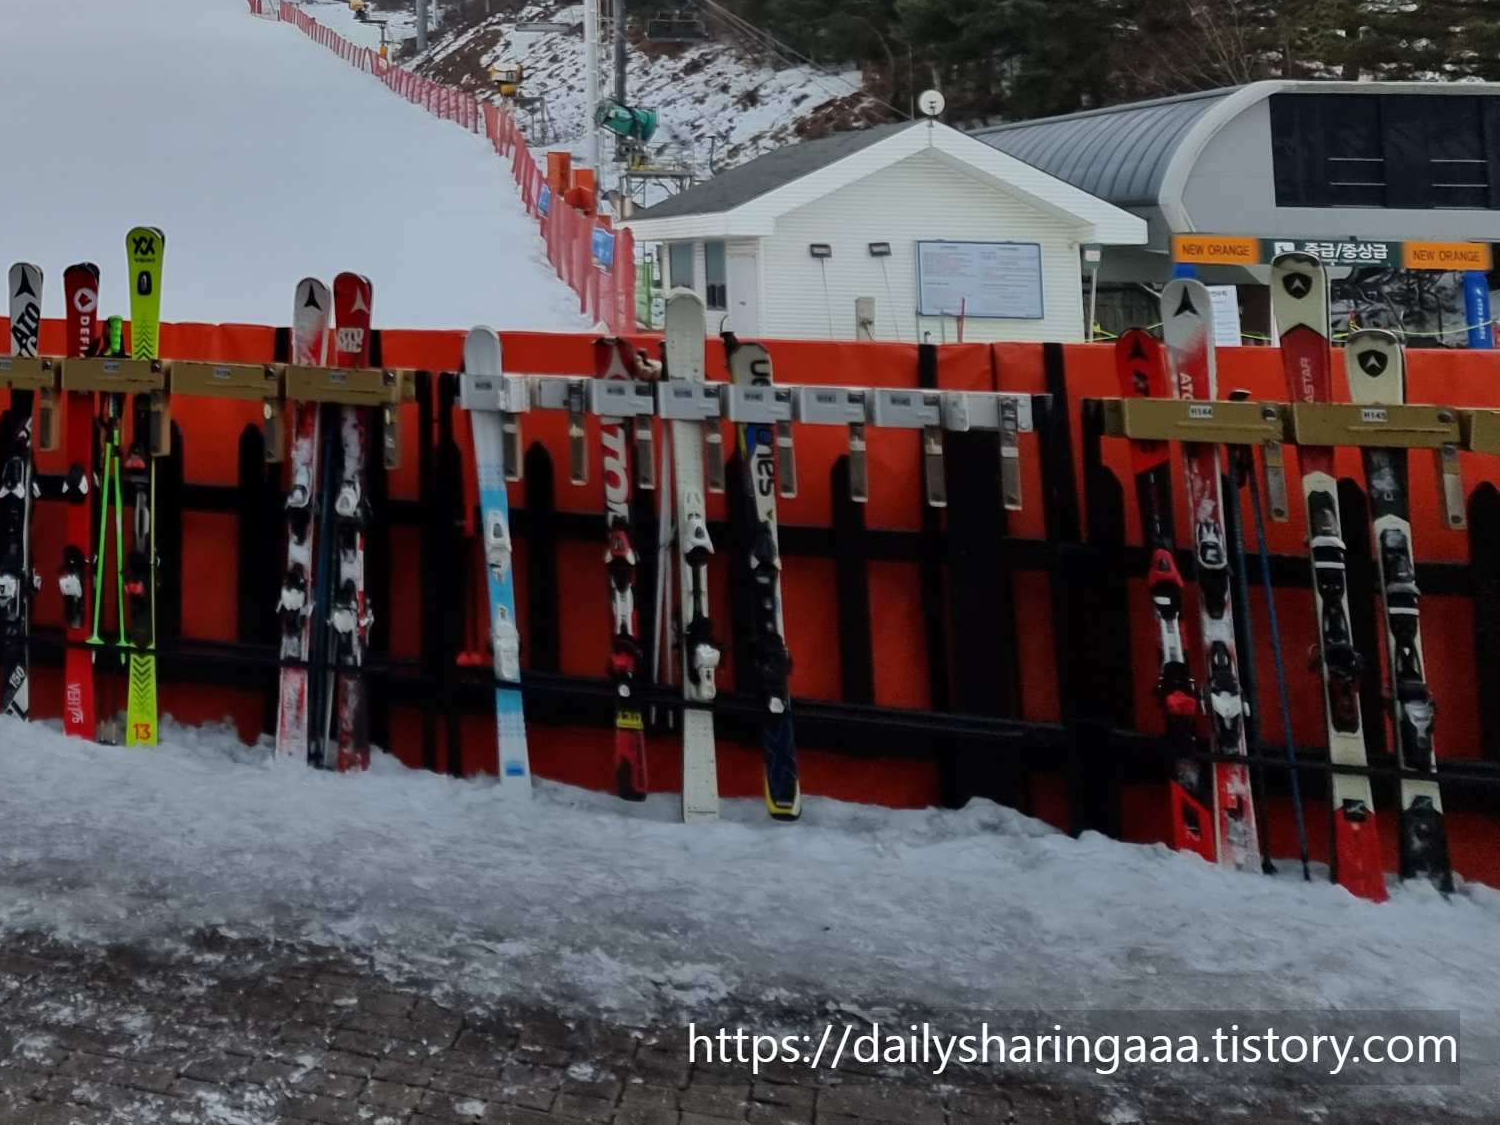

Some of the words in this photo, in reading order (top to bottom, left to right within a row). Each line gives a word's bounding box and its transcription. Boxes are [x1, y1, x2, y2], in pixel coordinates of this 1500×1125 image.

[1182, 244, 1204, 256] NEW
[1207, 244, 1249, 257] ORANGE
[1304, 241, 1389, 259] 중급/중상급
[1412, 249, 1435, 261] NEW
[1439, 250, 1481, 263] ORANGE
[1190, 407, 1212, 416] H144
[8, 665, 26, 689] 150
[133, 723, 151, 741] 13
